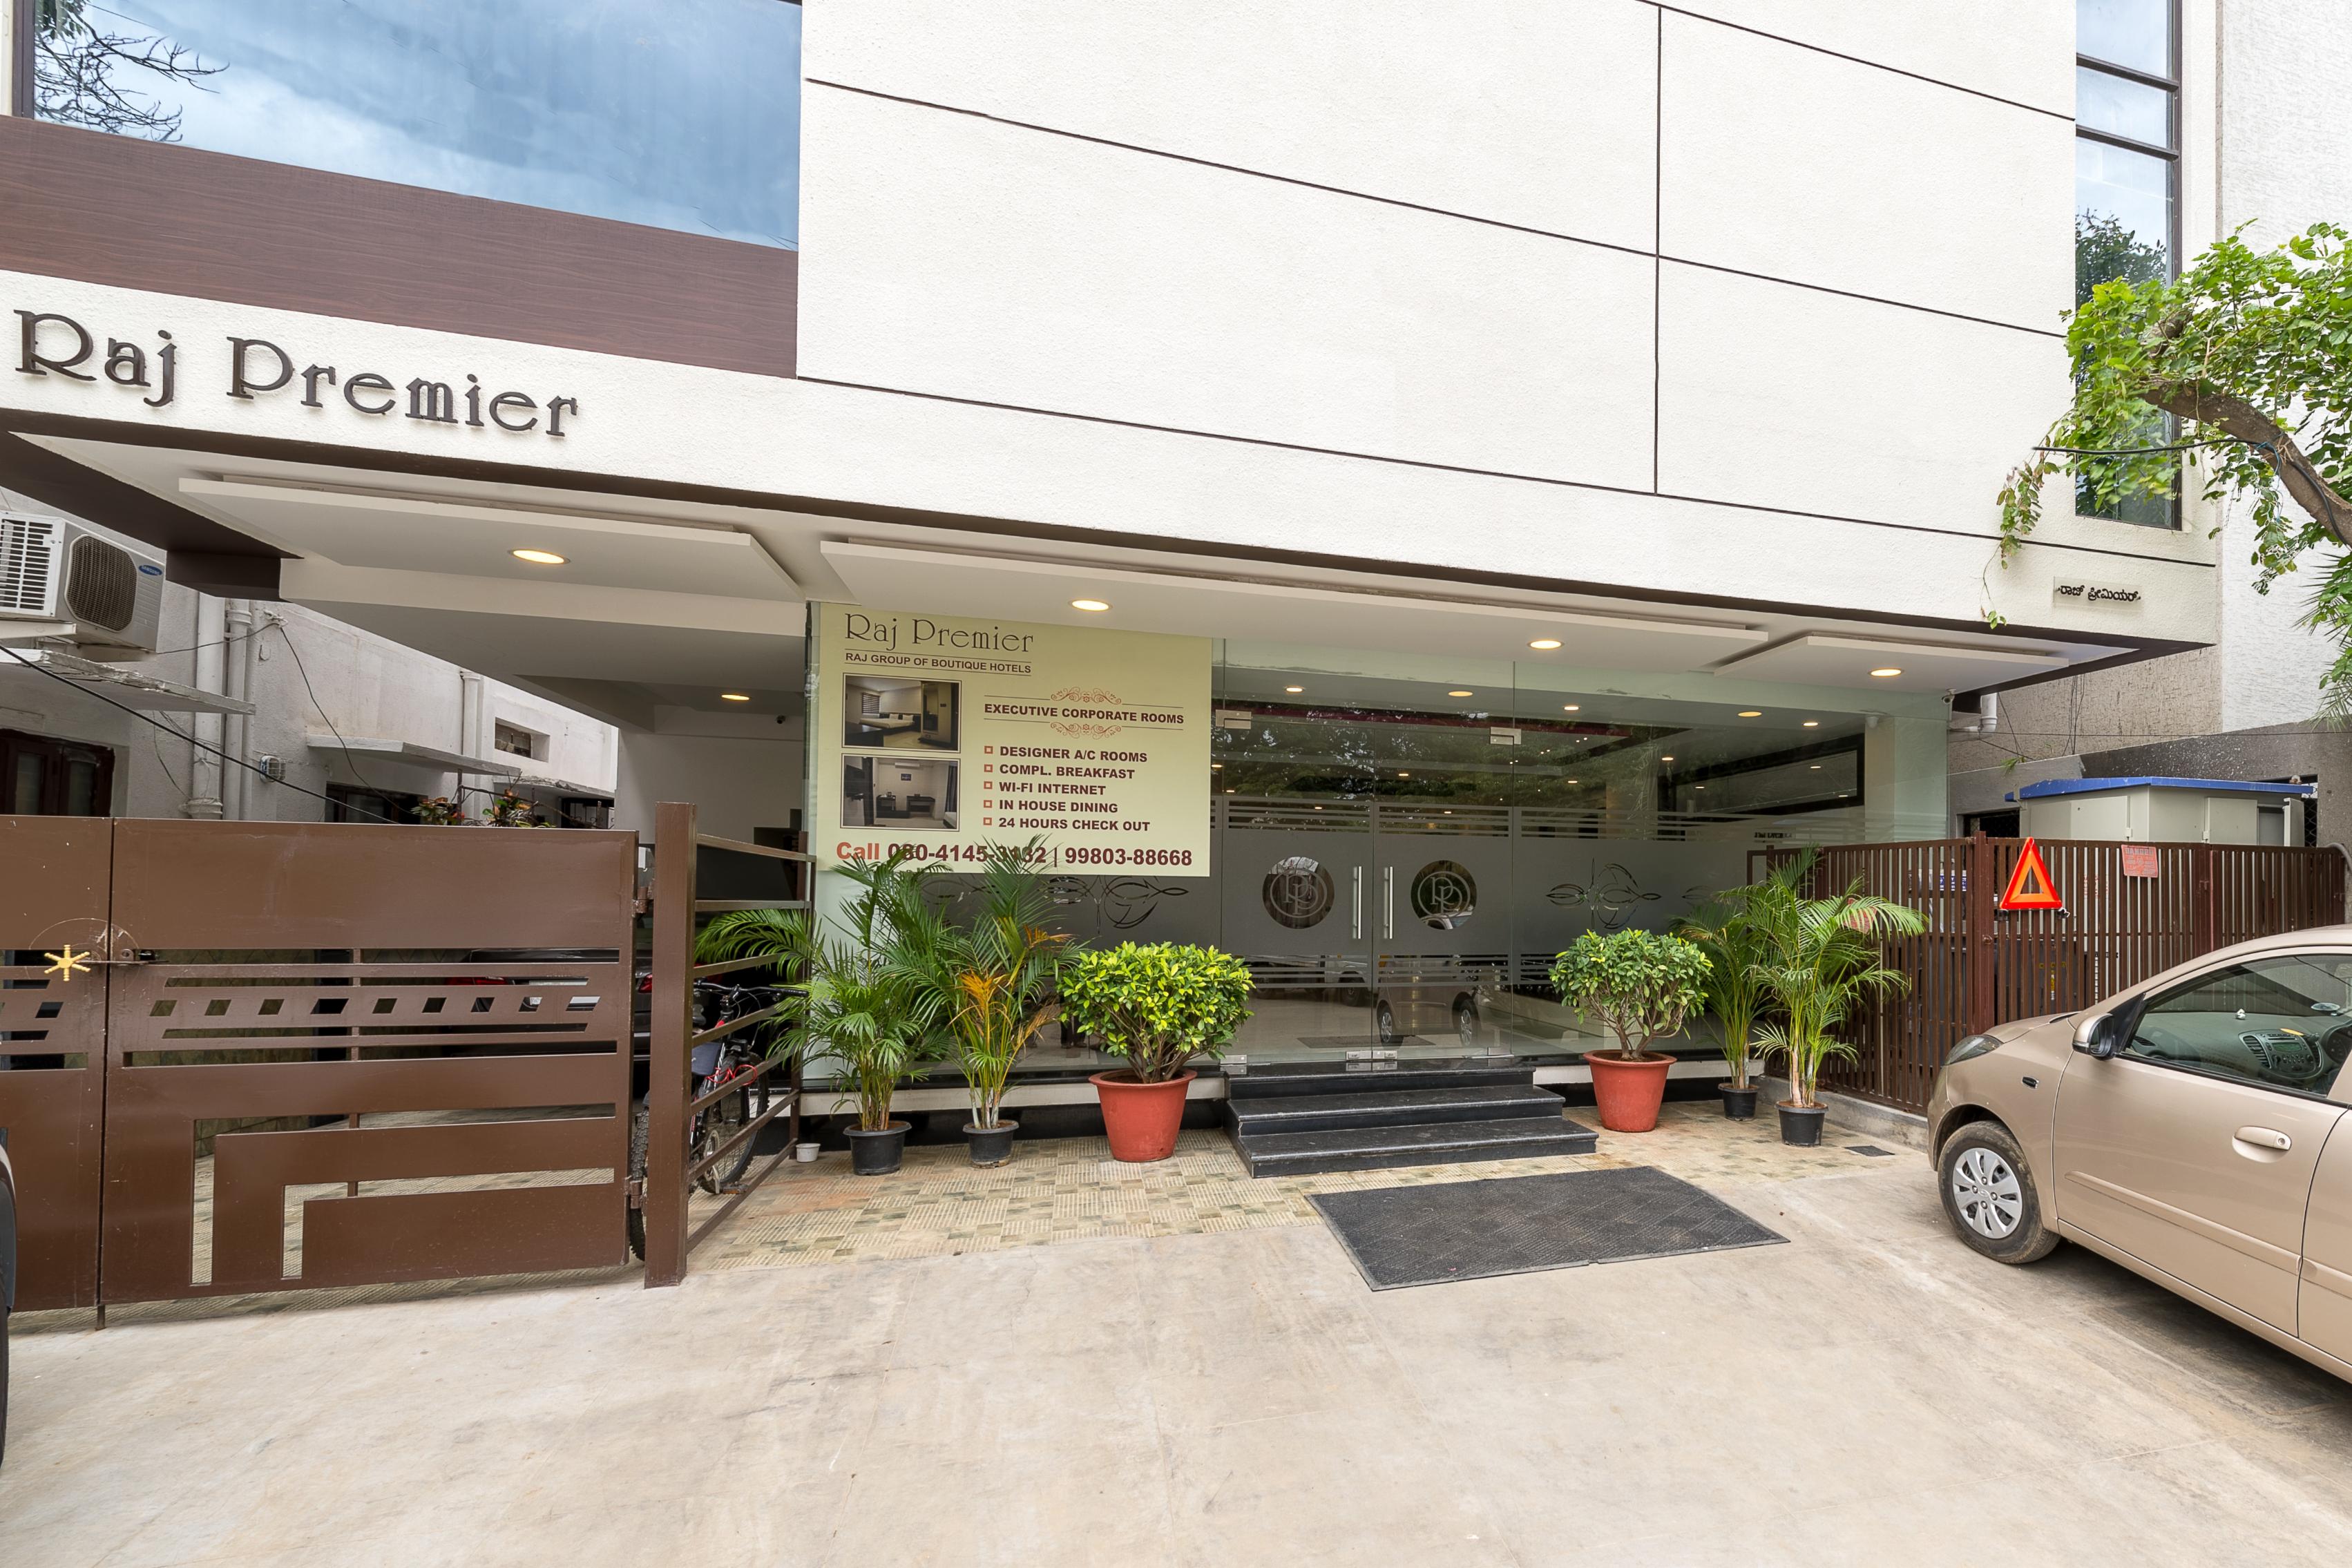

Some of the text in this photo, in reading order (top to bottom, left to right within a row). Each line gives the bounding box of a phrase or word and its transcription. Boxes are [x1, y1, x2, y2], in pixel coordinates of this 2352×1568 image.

[14, 309, 578, 438] Raj Premier
[845, 613, 1033, 653] Raj Premier
[845, 652, 1031, 673] RAJ GROUP OF BOUTIQUE HOTELS
[984, 703, 1184, 724] EXECUTIVE CORPORATE ROOMS
[1000, 746, 1148, 763] DESIGNER A/C ROOMS
[1000, 764, 1135, 779] COMPL. BREAKFAST
[999, 781, 1107, 796] WI-FI INTERNET
[1000, 799, 1118, 813] IN HOUSE DINING
[999, 817, 1151, 832] 24 HOURS CHECK OUT
[836, 841, 880, 860] Call
[1064, 847, 1192, 866] 99803-88668
